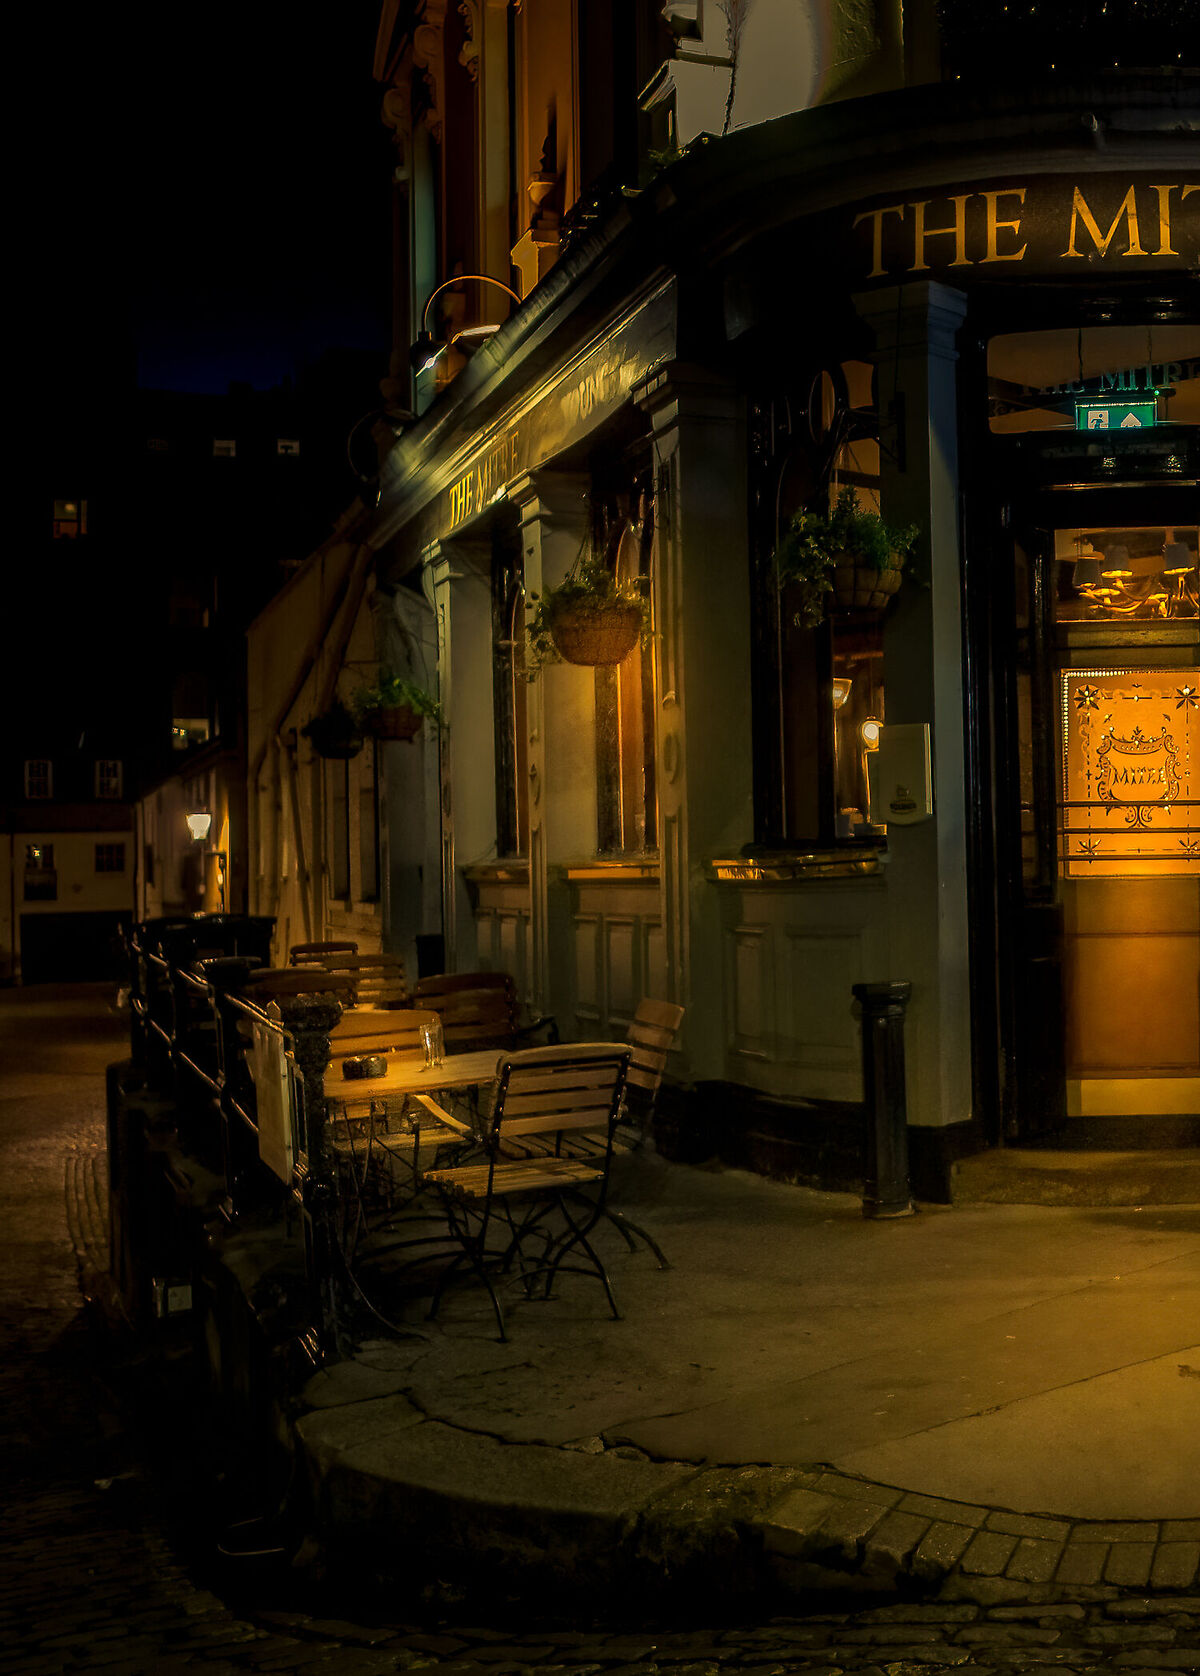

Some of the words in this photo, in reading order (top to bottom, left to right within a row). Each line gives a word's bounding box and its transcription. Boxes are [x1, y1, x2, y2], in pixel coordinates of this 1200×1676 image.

[852, 188, 1028, 278] THE
[449, 470, 475, 529] THE
[475, 431, 520, 513] MITRE
